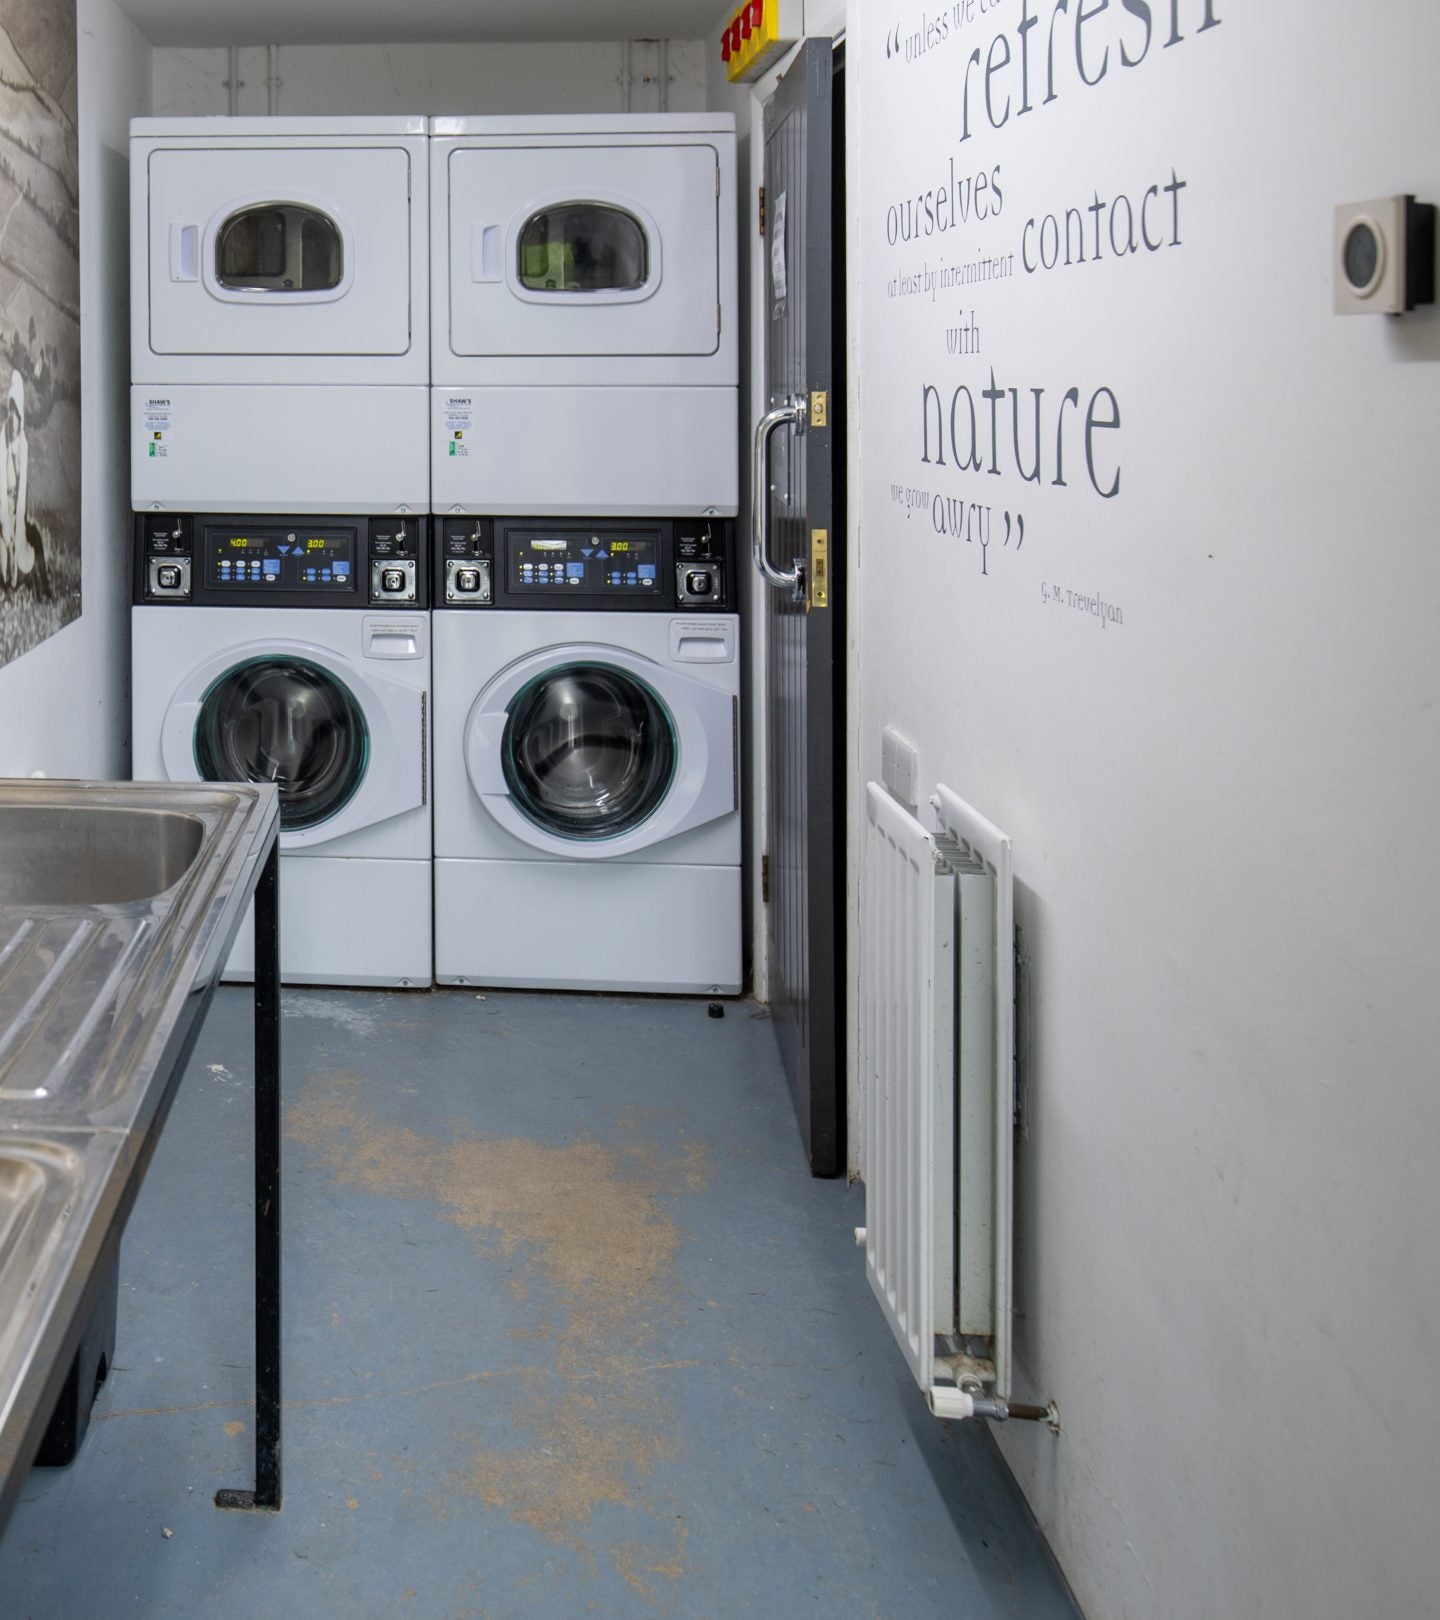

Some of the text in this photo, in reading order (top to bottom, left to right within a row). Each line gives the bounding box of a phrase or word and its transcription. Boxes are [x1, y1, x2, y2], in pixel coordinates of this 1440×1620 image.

[952, 0, 975, 31] we
[887, 157, 1003, 246] ourselves
[887, 166, 1187, 302] at least by intermittent contact
[946, 309, 980, 354] with
[921, 366, 1121, 498] nature
[891, 484, 903, 504] we
[906, 488, 929, 520] grow
[1067, 589, 1124, 629] Trevelyan
